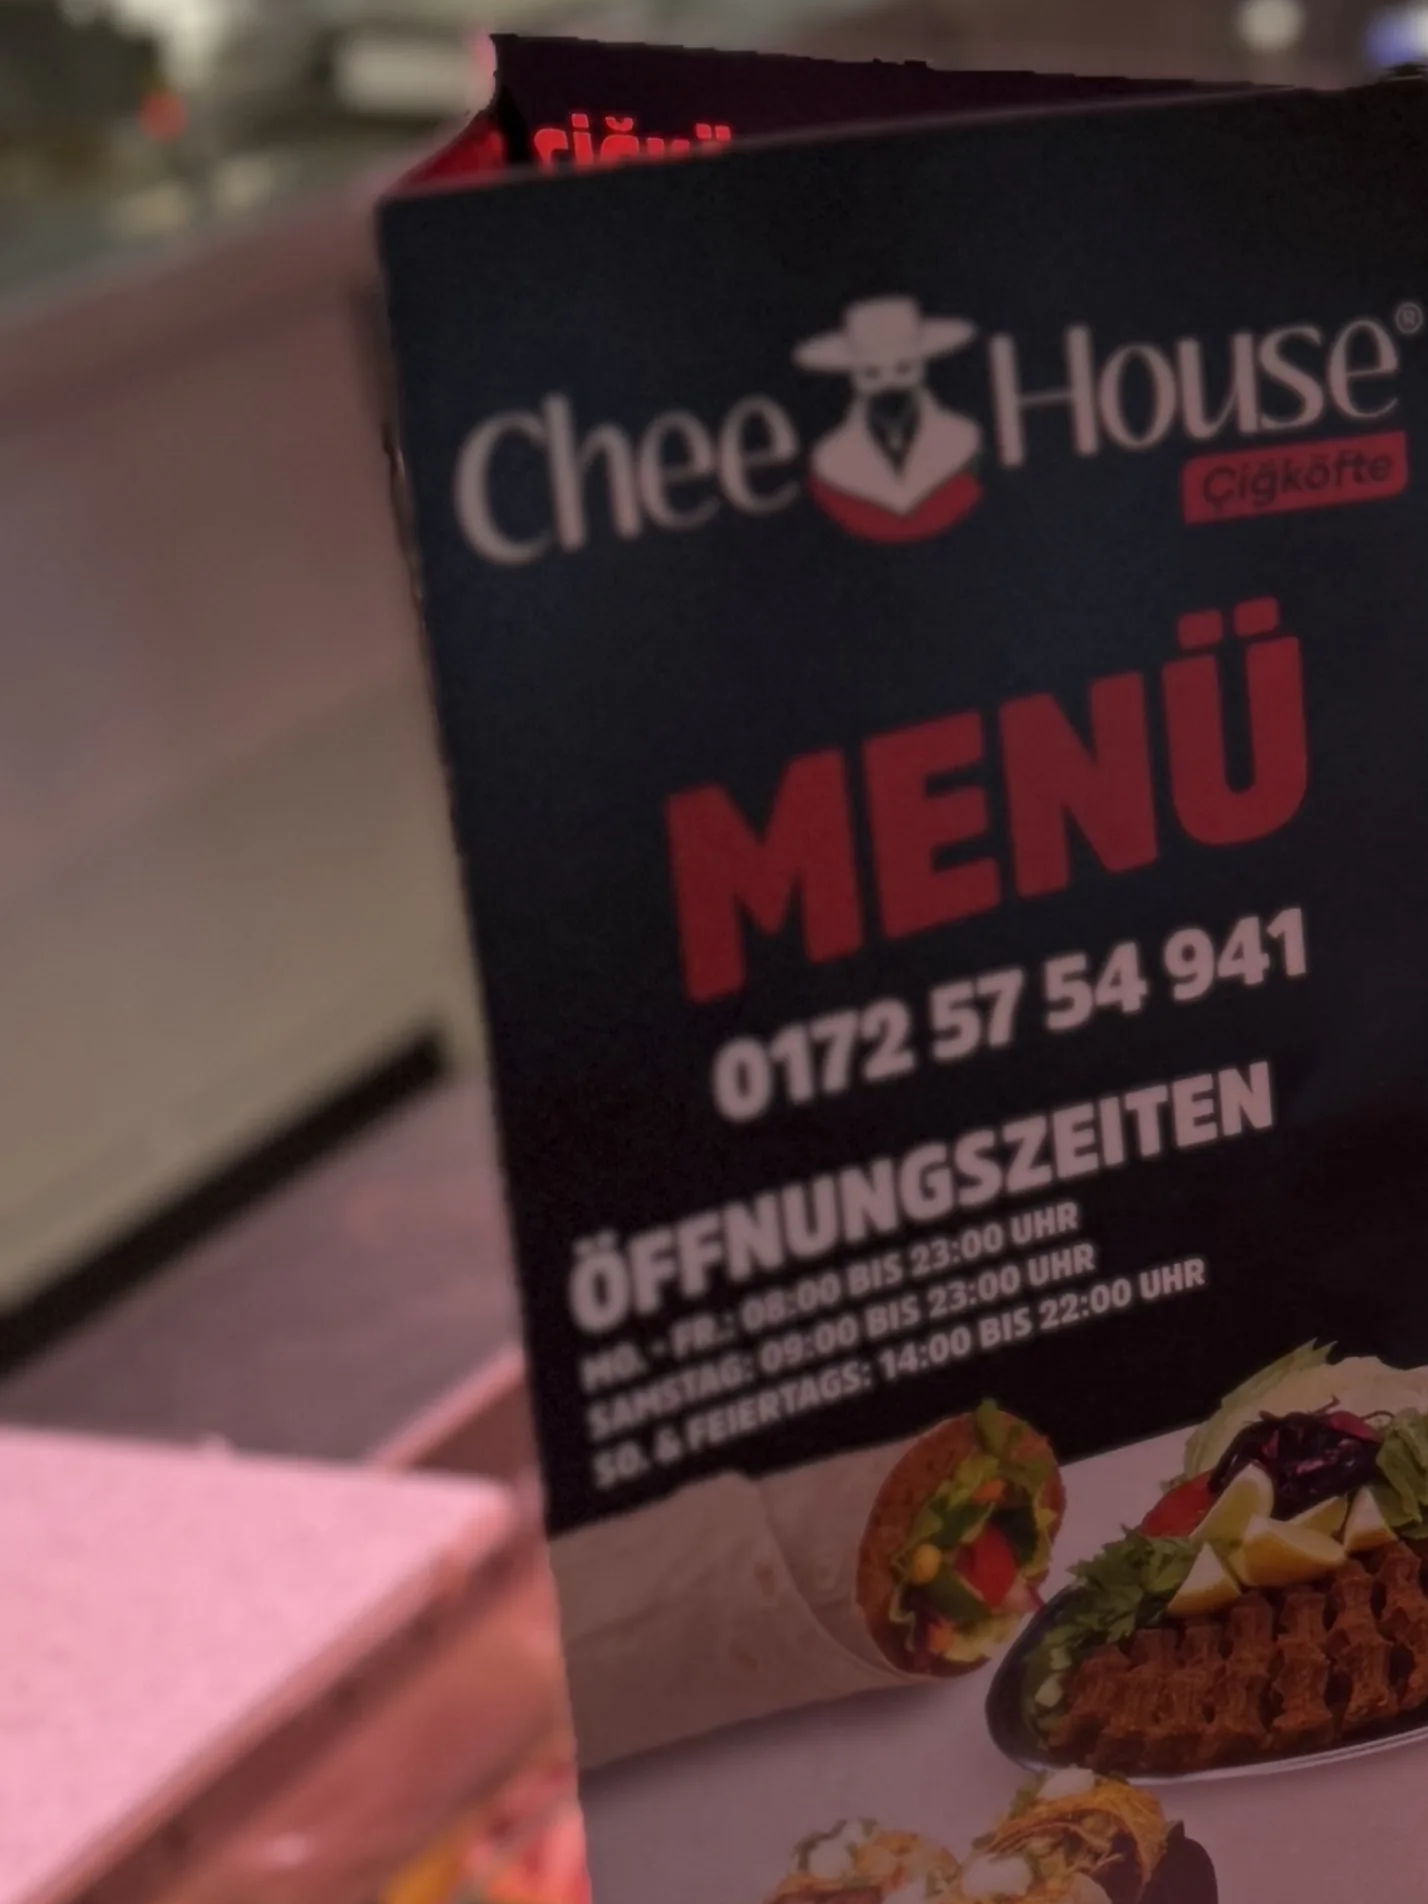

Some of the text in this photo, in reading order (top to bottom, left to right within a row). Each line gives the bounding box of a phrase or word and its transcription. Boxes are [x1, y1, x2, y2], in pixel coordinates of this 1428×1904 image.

[453, 392, 800, 566] Chee
[1202, 449, 1395, 513] Çiğköfte
[665, 596, 1307, 1003] MENÜ
[711, 907, 1307, 1123] 0172 57 54 941
[569, 1060, 1273, 1335] ÖFFNUNGSZEITEN
[847, 1251, 902, 1296] BIS
[910, 1223, 1003, 1277] 23:00
[1010, 1201, 1079, 1245] UHR
[685, 1358, 873, 1452] FEIERTAGS:
[879, 1326, 972, 1380] 14:00
[979, 1306, 1033, 1350] BIS
[1039, 1277, 1132, 1330] 22:00
[1139, 1257, 1206, 1301] UHR
[759, 1308, 859, 1373] 09:00
[864, 1295, 920, 1341] BIS
[927, 1264, 1020, 1318] 23:00
[1027, 1242, 1095, 1287] UHR
